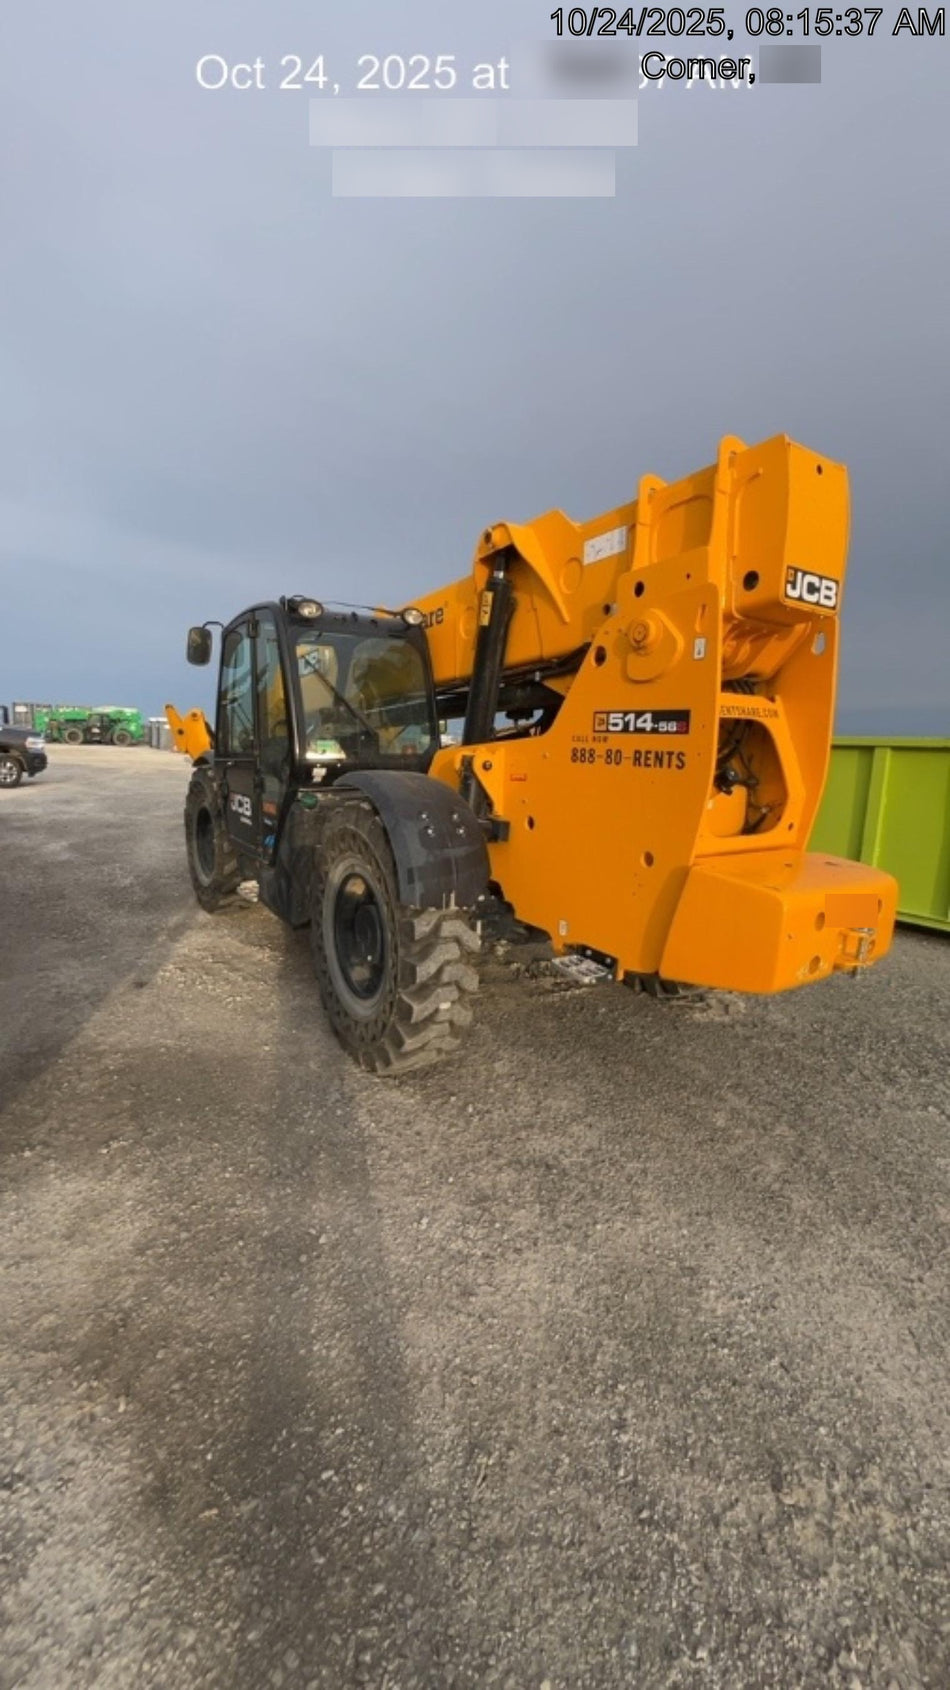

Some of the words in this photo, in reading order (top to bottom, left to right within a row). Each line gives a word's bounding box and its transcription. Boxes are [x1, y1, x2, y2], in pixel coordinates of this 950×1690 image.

[786, 571, 837, 608] JCB
[571, 747, 686, 770] 888-80-RENTS
[230, 793, 252, 816] JCB
